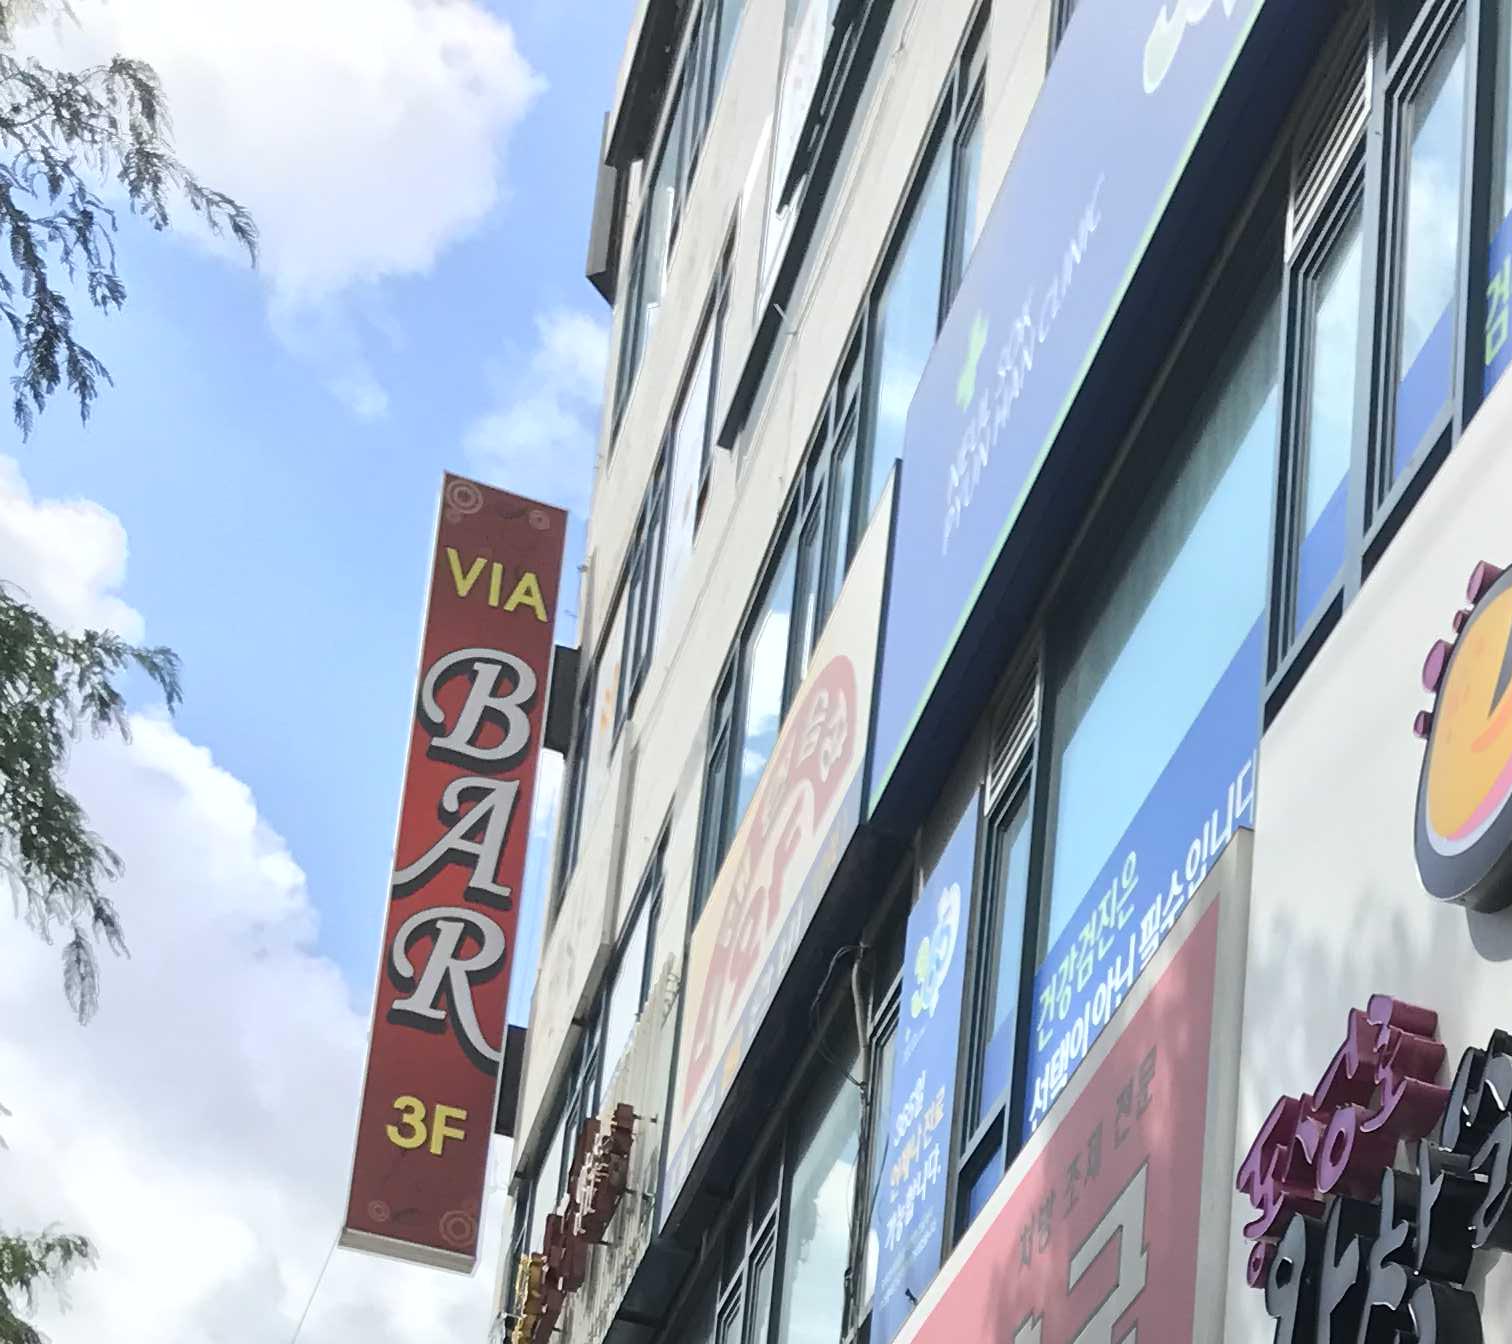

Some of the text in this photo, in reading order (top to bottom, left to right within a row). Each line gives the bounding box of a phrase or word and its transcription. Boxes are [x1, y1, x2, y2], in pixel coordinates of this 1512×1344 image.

[446, 545, 549, 623] VIA
[392, 646, 538, 1065] BAR
[386, 1094, 468, 1157] 3F
